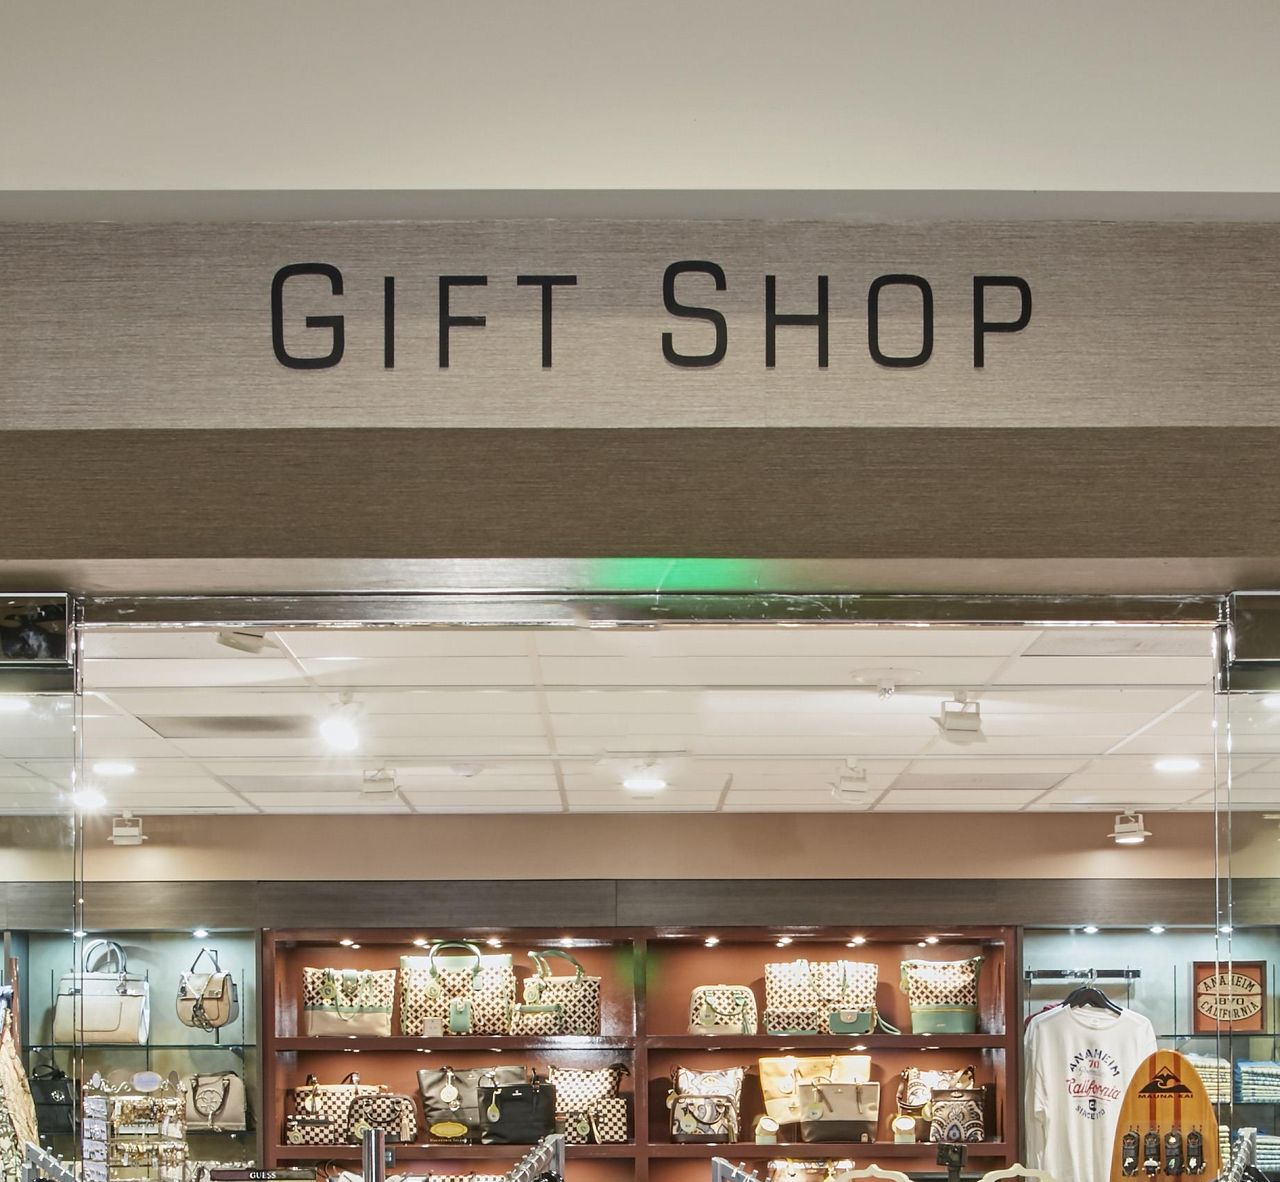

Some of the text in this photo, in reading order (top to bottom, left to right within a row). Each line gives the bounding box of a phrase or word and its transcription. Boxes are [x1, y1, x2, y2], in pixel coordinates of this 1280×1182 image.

[271, 259, 1033, 370] GIFT SHOP
[1070, 1048, 1120, 1077] ANAHEIM
[1066, 1078, 1120, 1100] California
